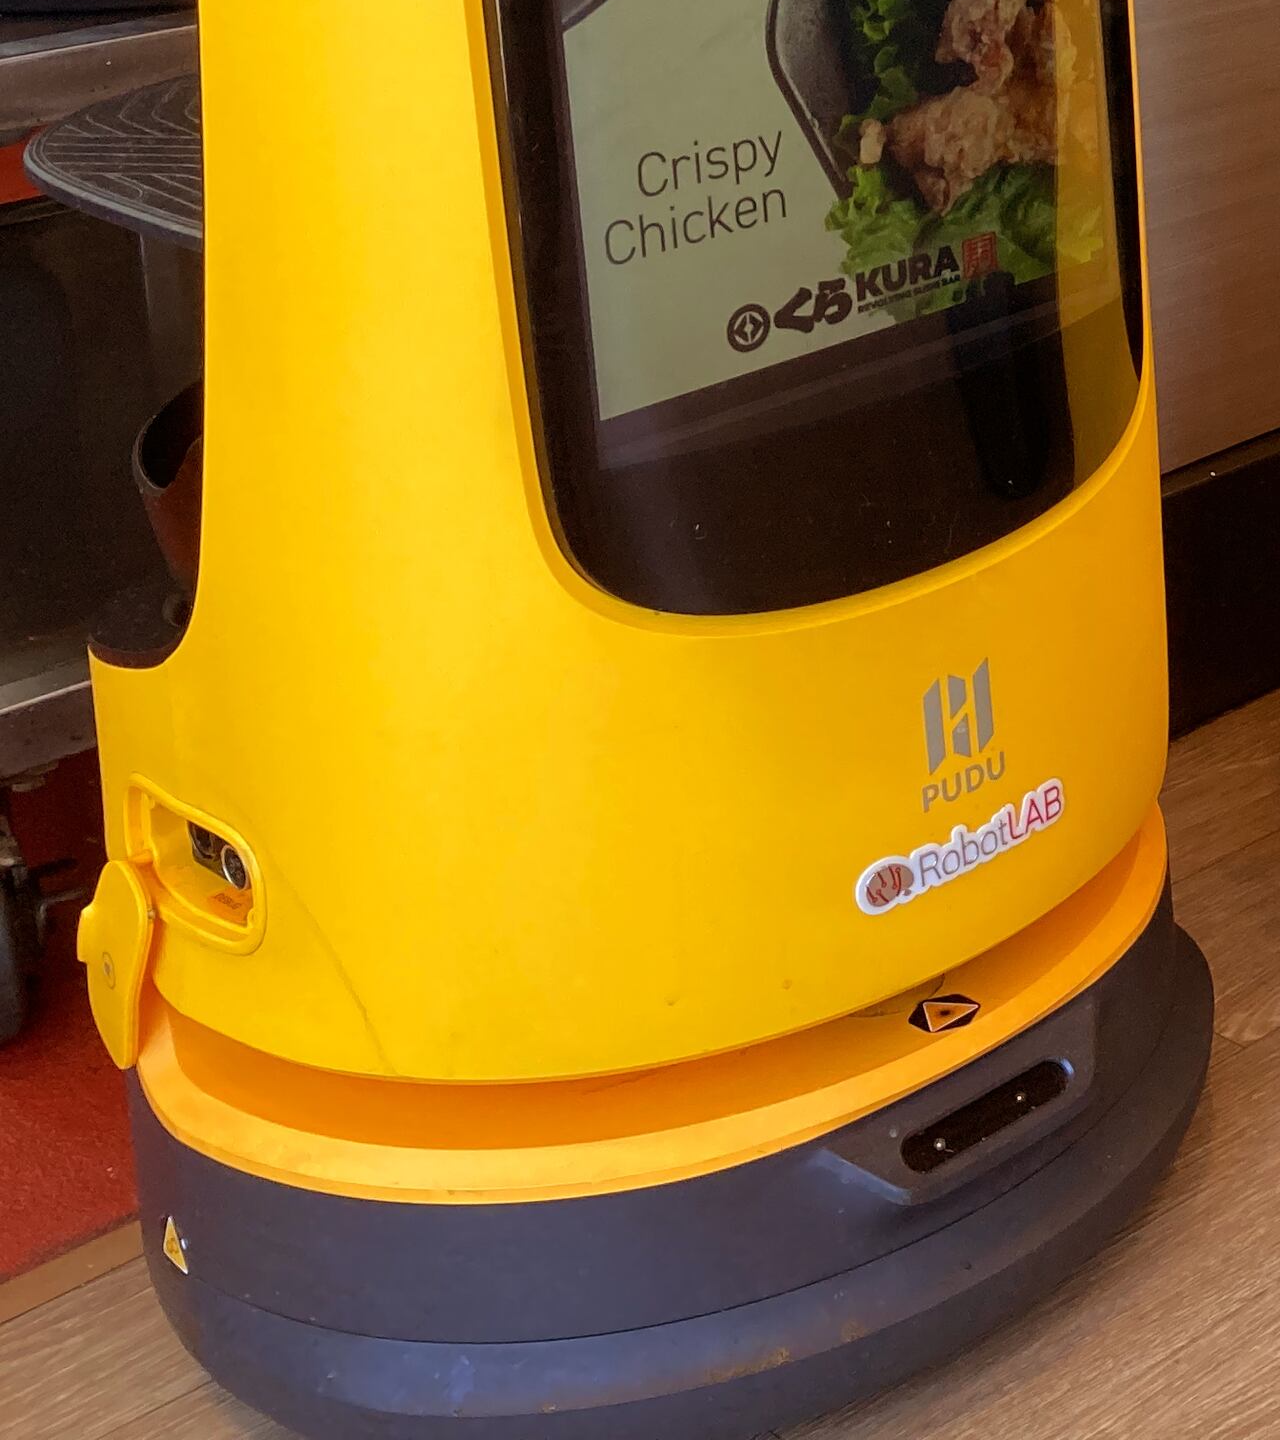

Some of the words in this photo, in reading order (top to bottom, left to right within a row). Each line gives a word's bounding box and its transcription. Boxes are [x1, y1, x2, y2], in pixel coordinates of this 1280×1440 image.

[637, 130, 782, 197] Crispy
[605, 189, 787, 265] Chicken
[855, 245, 960, 302] KURA
[921, 751, 1007, 814] PUDU
[918, 785, 1063, 888] RobotLAB
